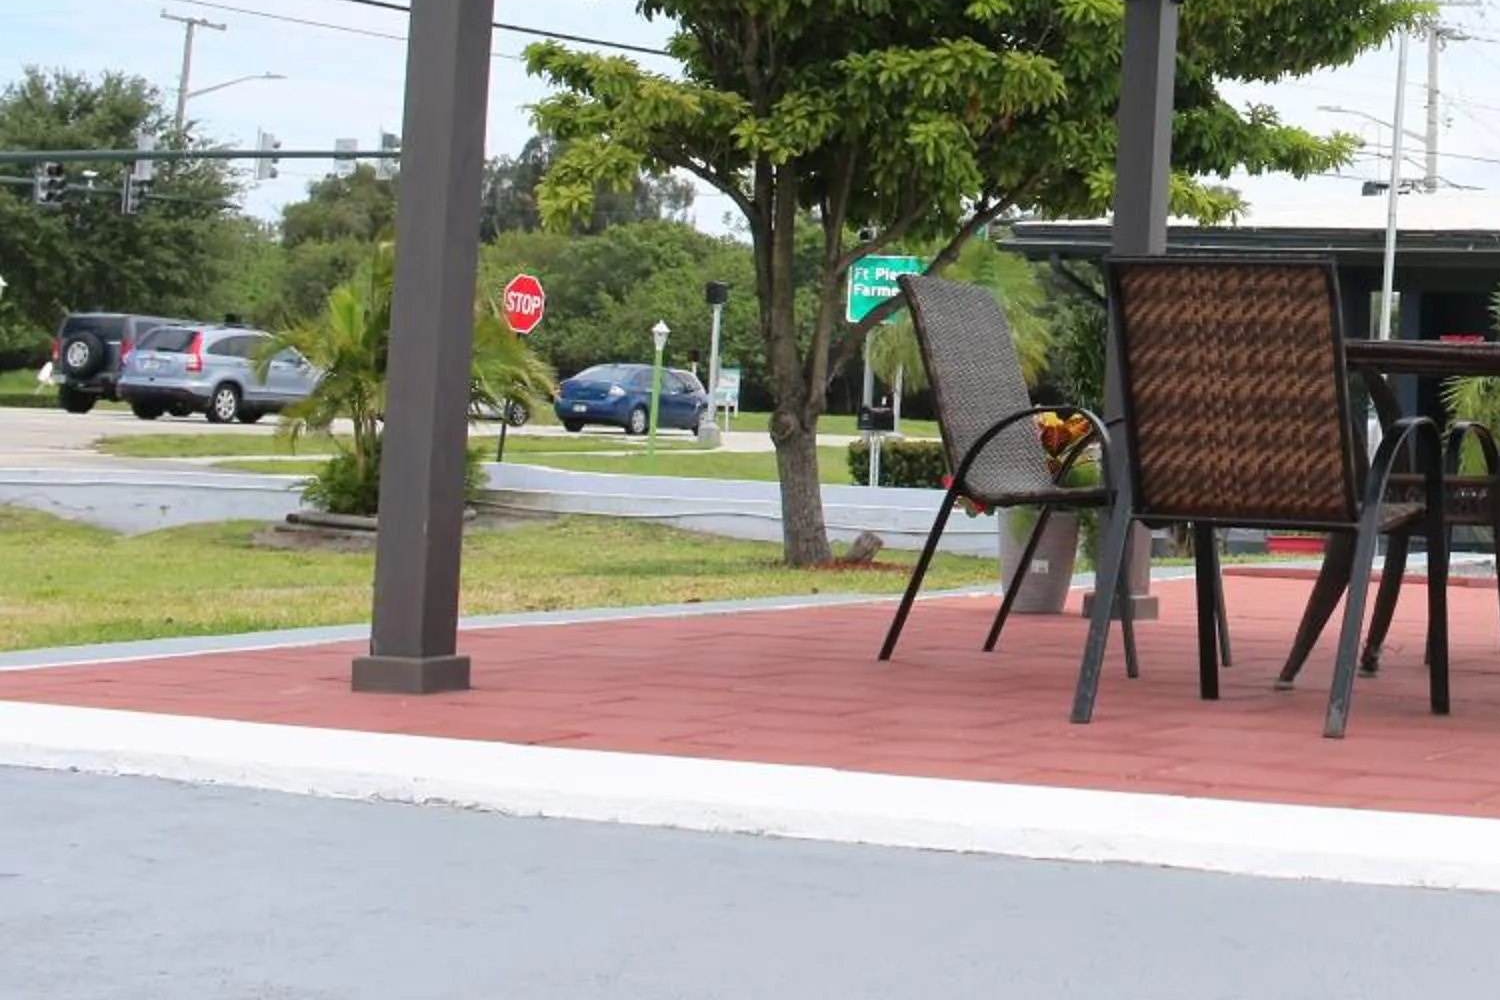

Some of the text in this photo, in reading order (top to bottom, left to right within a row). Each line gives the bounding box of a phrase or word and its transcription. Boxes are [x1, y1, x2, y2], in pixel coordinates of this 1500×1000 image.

[853, 266, 869, 281] Ft
[853, 283, 902, 297] Farme
[507, 291, 541, 316] STOP
